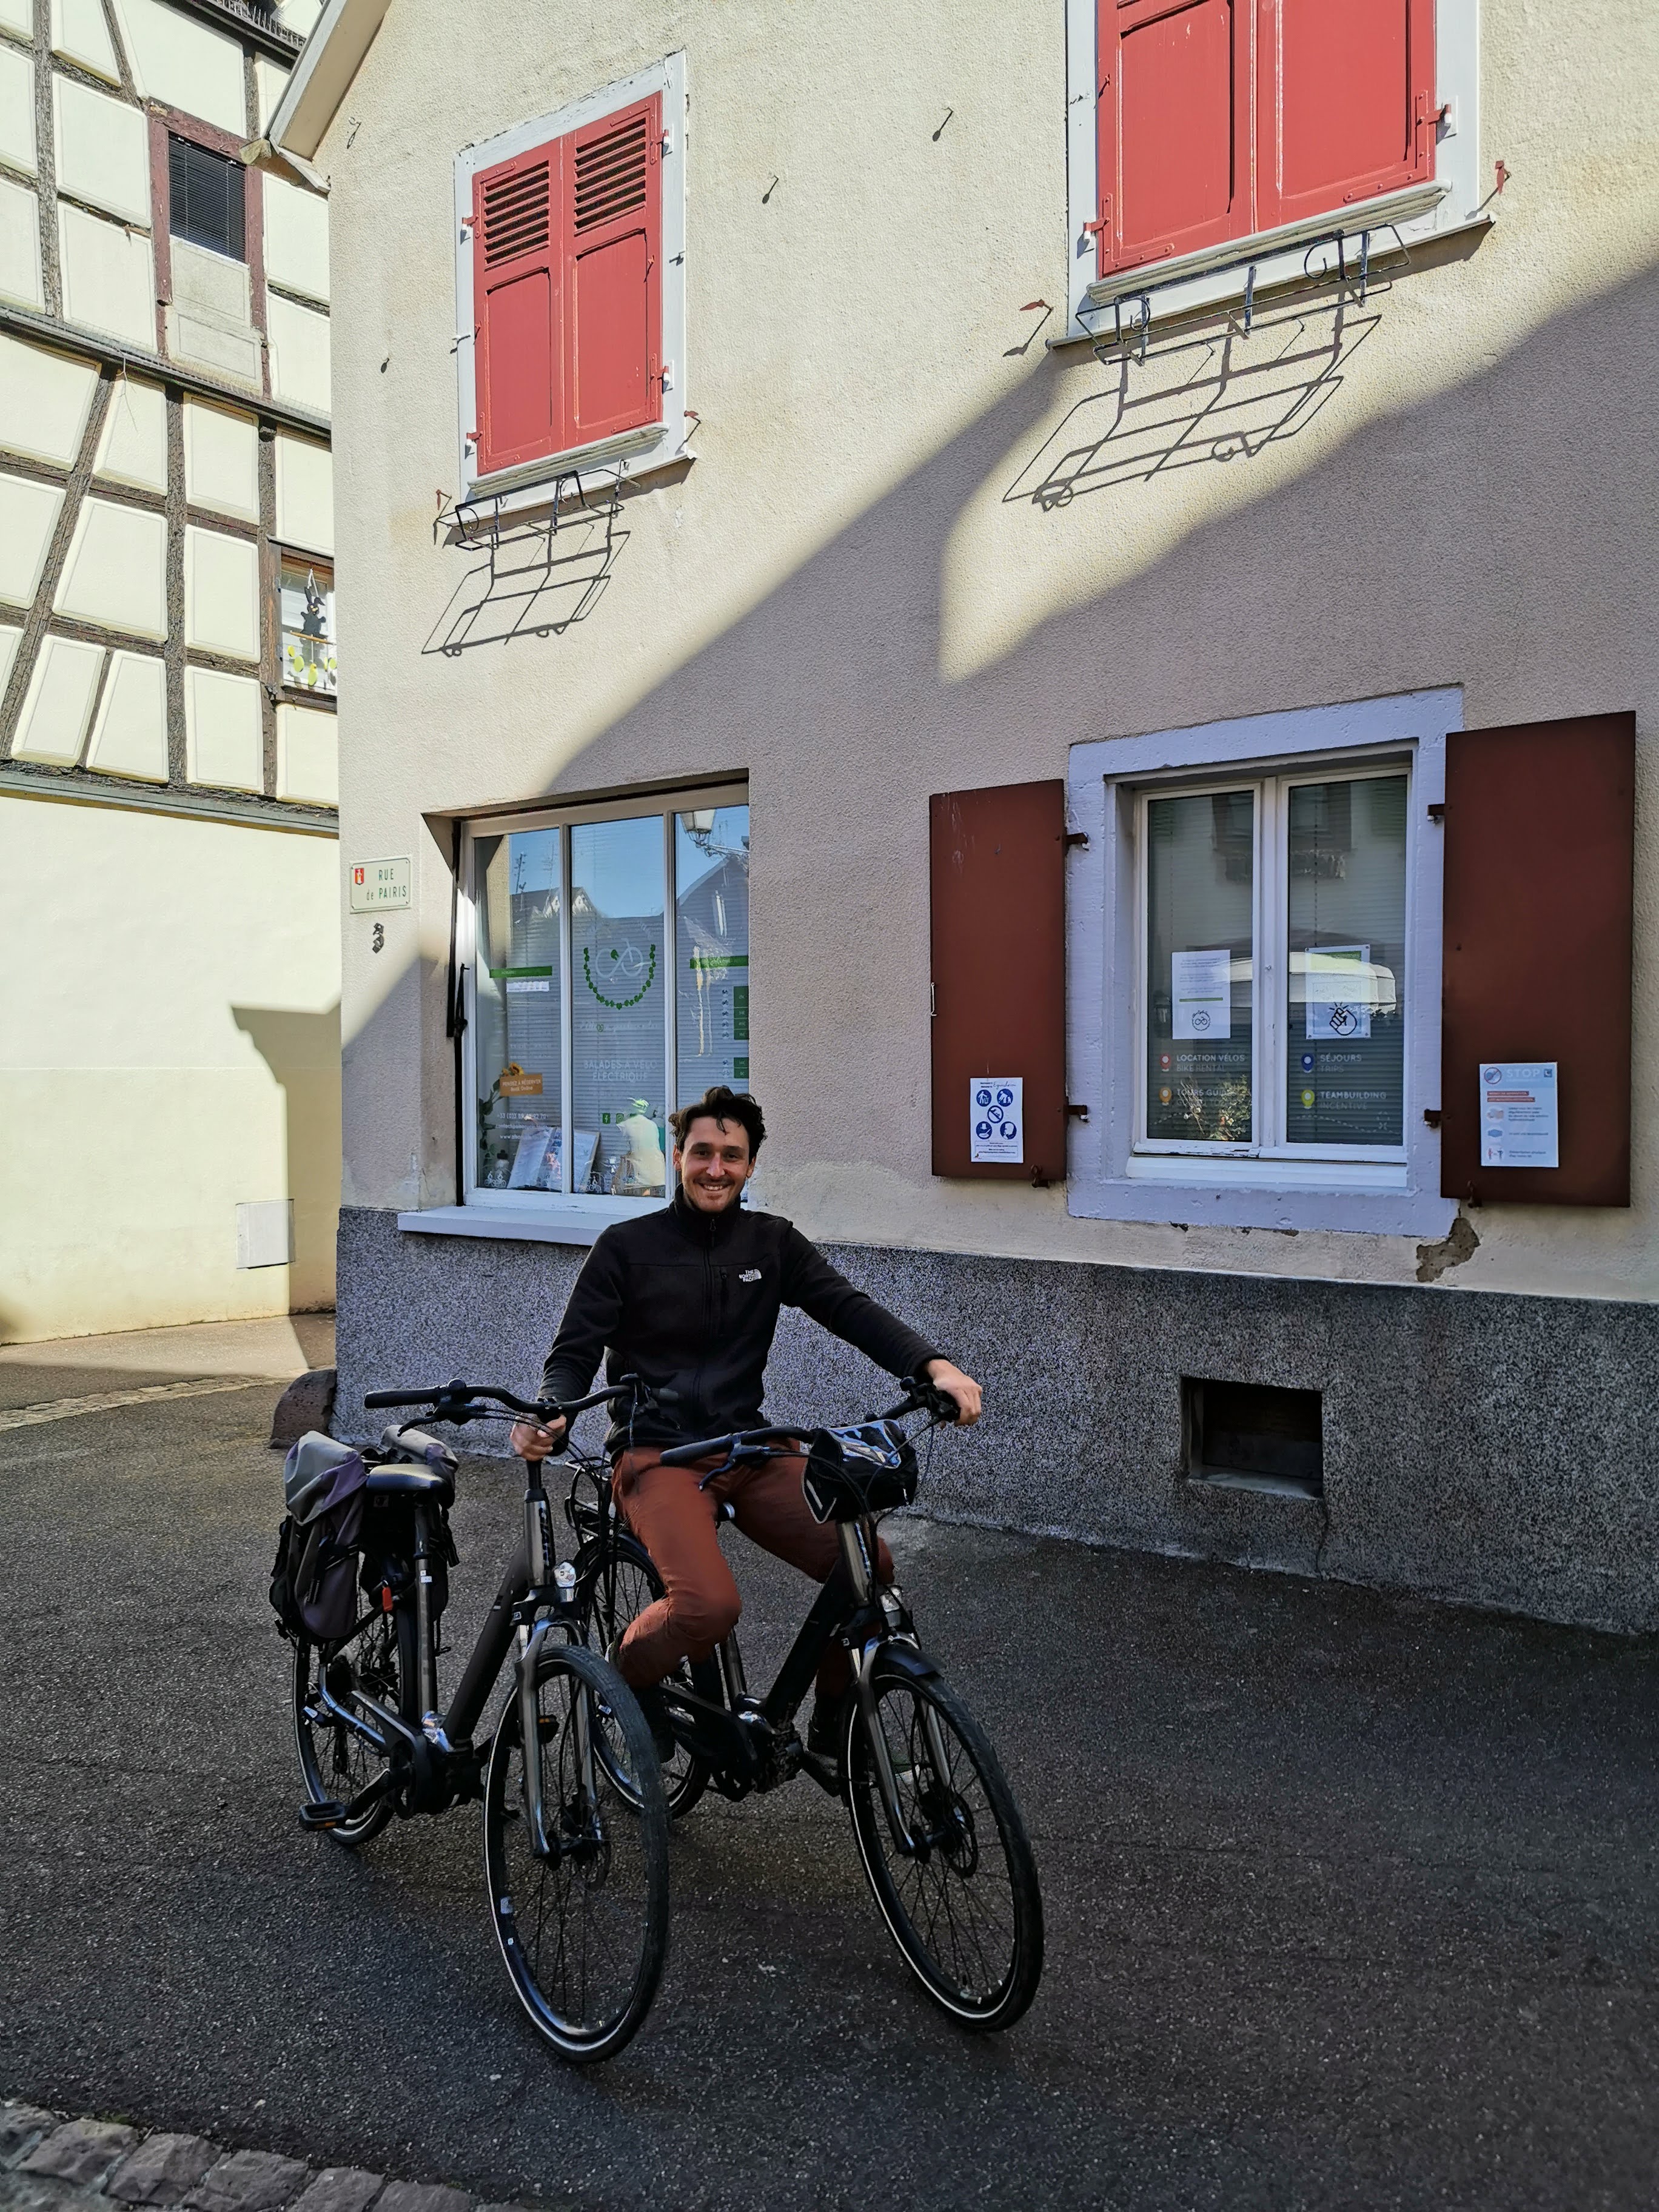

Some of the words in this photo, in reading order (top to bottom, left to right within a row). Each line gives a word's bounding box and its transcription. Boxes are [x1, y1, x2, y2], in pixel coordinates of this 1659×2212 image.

[378, 868, 394, 880] RUE
[366, 888, 374, 900] de
[379, 885, 407, 899] PAIRIS
[1218, 1053, 1246, 1062] VÉLOS
[1320, 1053, 1362, 1062] SÉJOURS
[584, 1059, 623, 1069] BALADES
[1506, 1068, 1541, 1078] STOP
[1320, 1091, 1387, 1099] TEAMBUILDING
[1320, 1101, 1367, 1110] INCENTIVE
